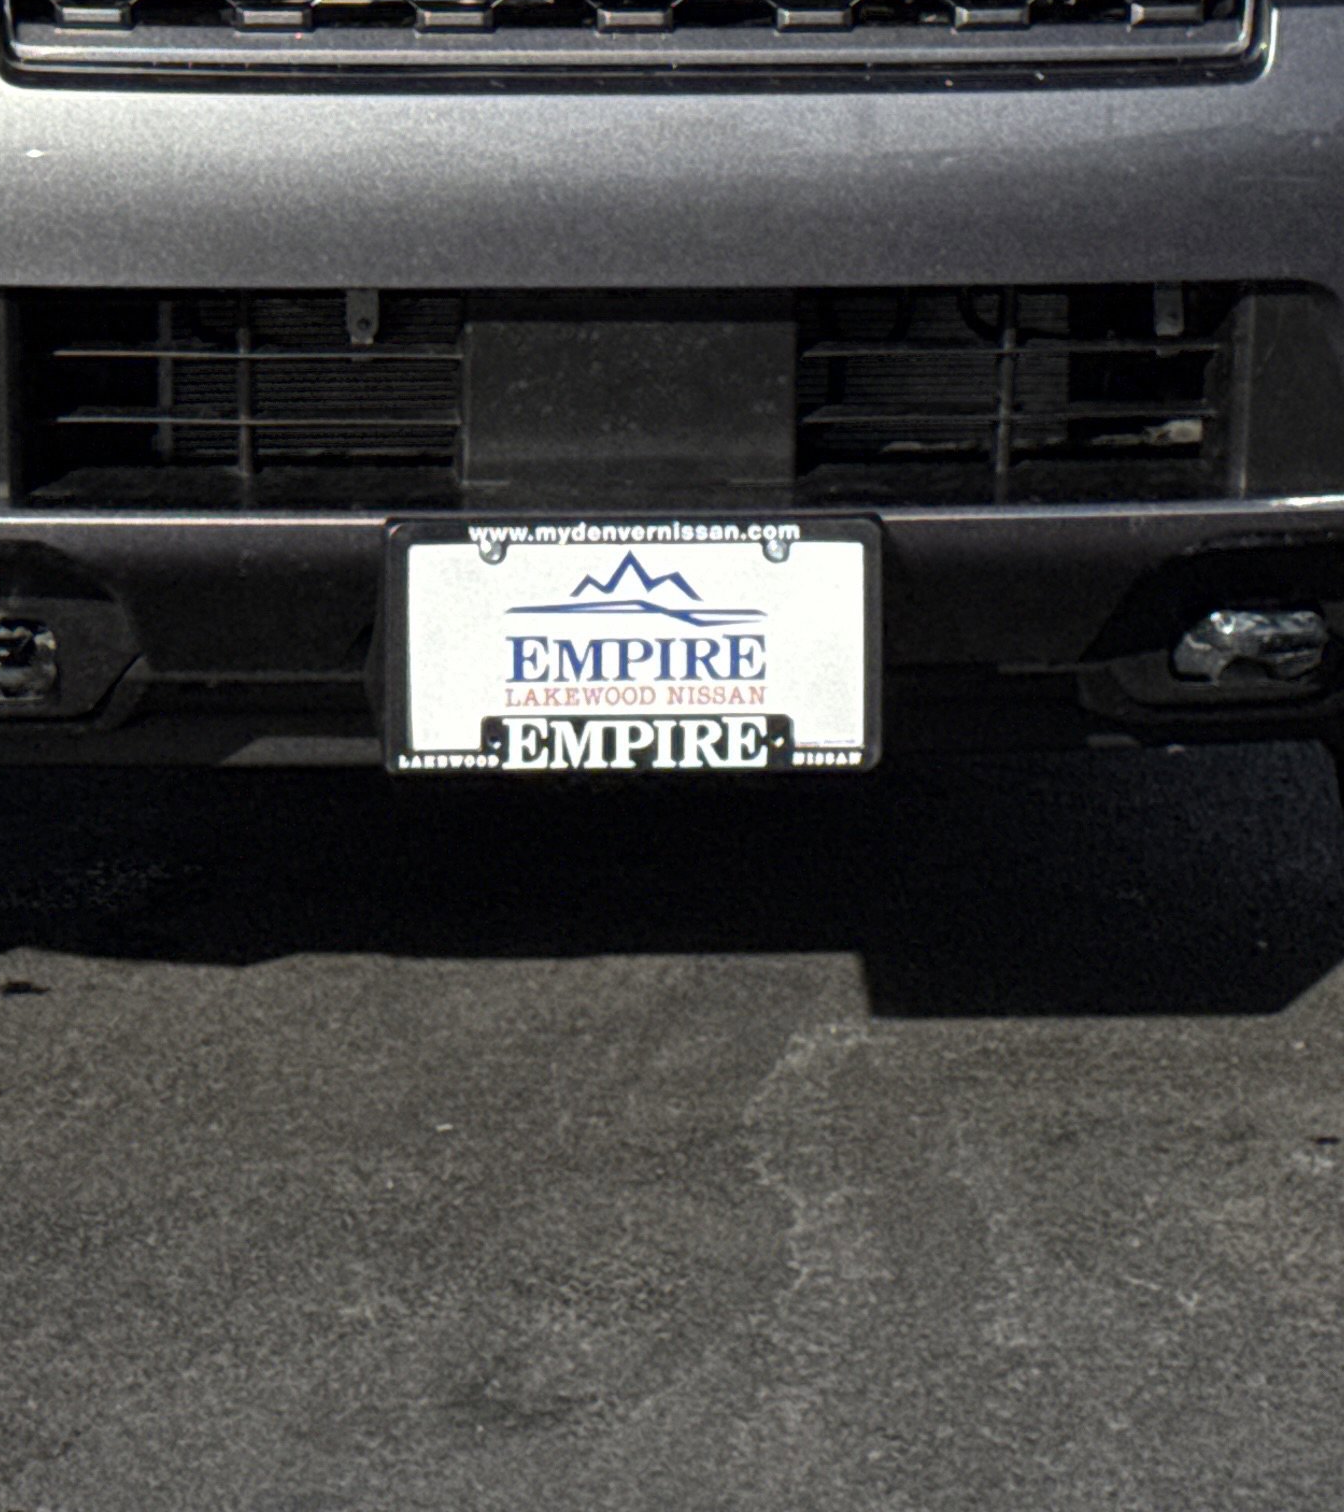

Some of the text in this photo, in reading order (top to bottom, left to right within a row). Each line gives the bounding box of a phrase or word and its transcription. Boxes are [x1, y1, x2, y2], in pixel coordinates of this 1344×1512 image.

[468, 522, 801, 544] www.mydenvernissan.com
[505, 633, 767, 684] EMPIRE
[505, 685, 769, 707] LAKEWOOD NISSAN
[501, 715, 769, 770] EMPIRE
